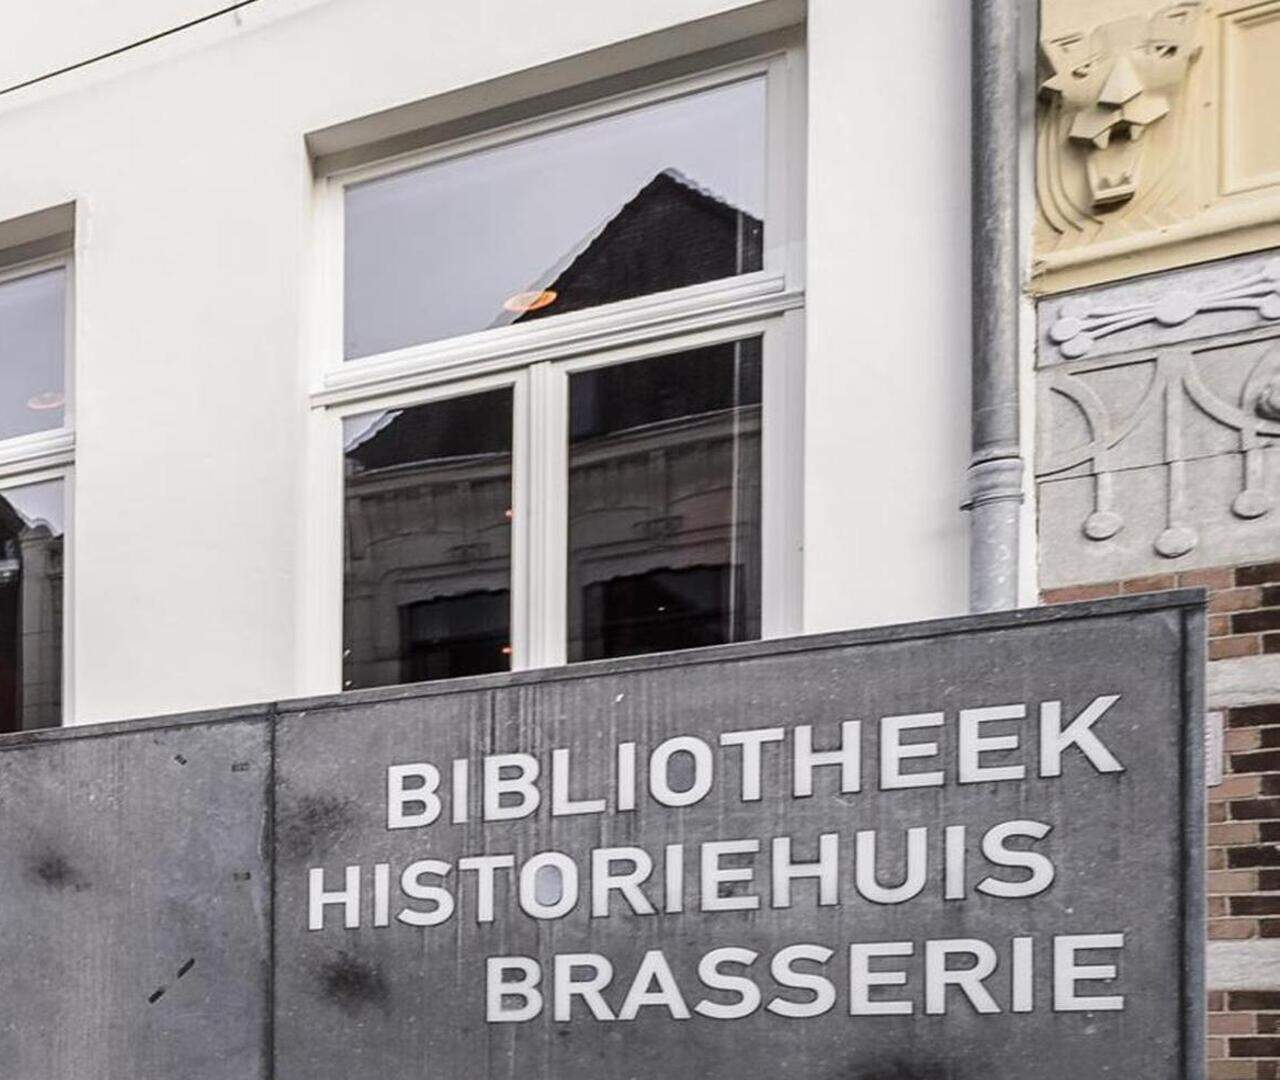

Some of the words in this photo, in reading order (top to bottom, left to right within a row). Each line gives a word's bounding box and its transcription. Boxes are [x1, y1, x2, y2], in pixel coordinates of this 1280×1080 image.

[385, 693, 1124, 831] BIBLIOTHEEK
[307, 819, 1057, 932] HISTORIEHUIS
[485, 932, 1125, 1024] BRASSERIE
